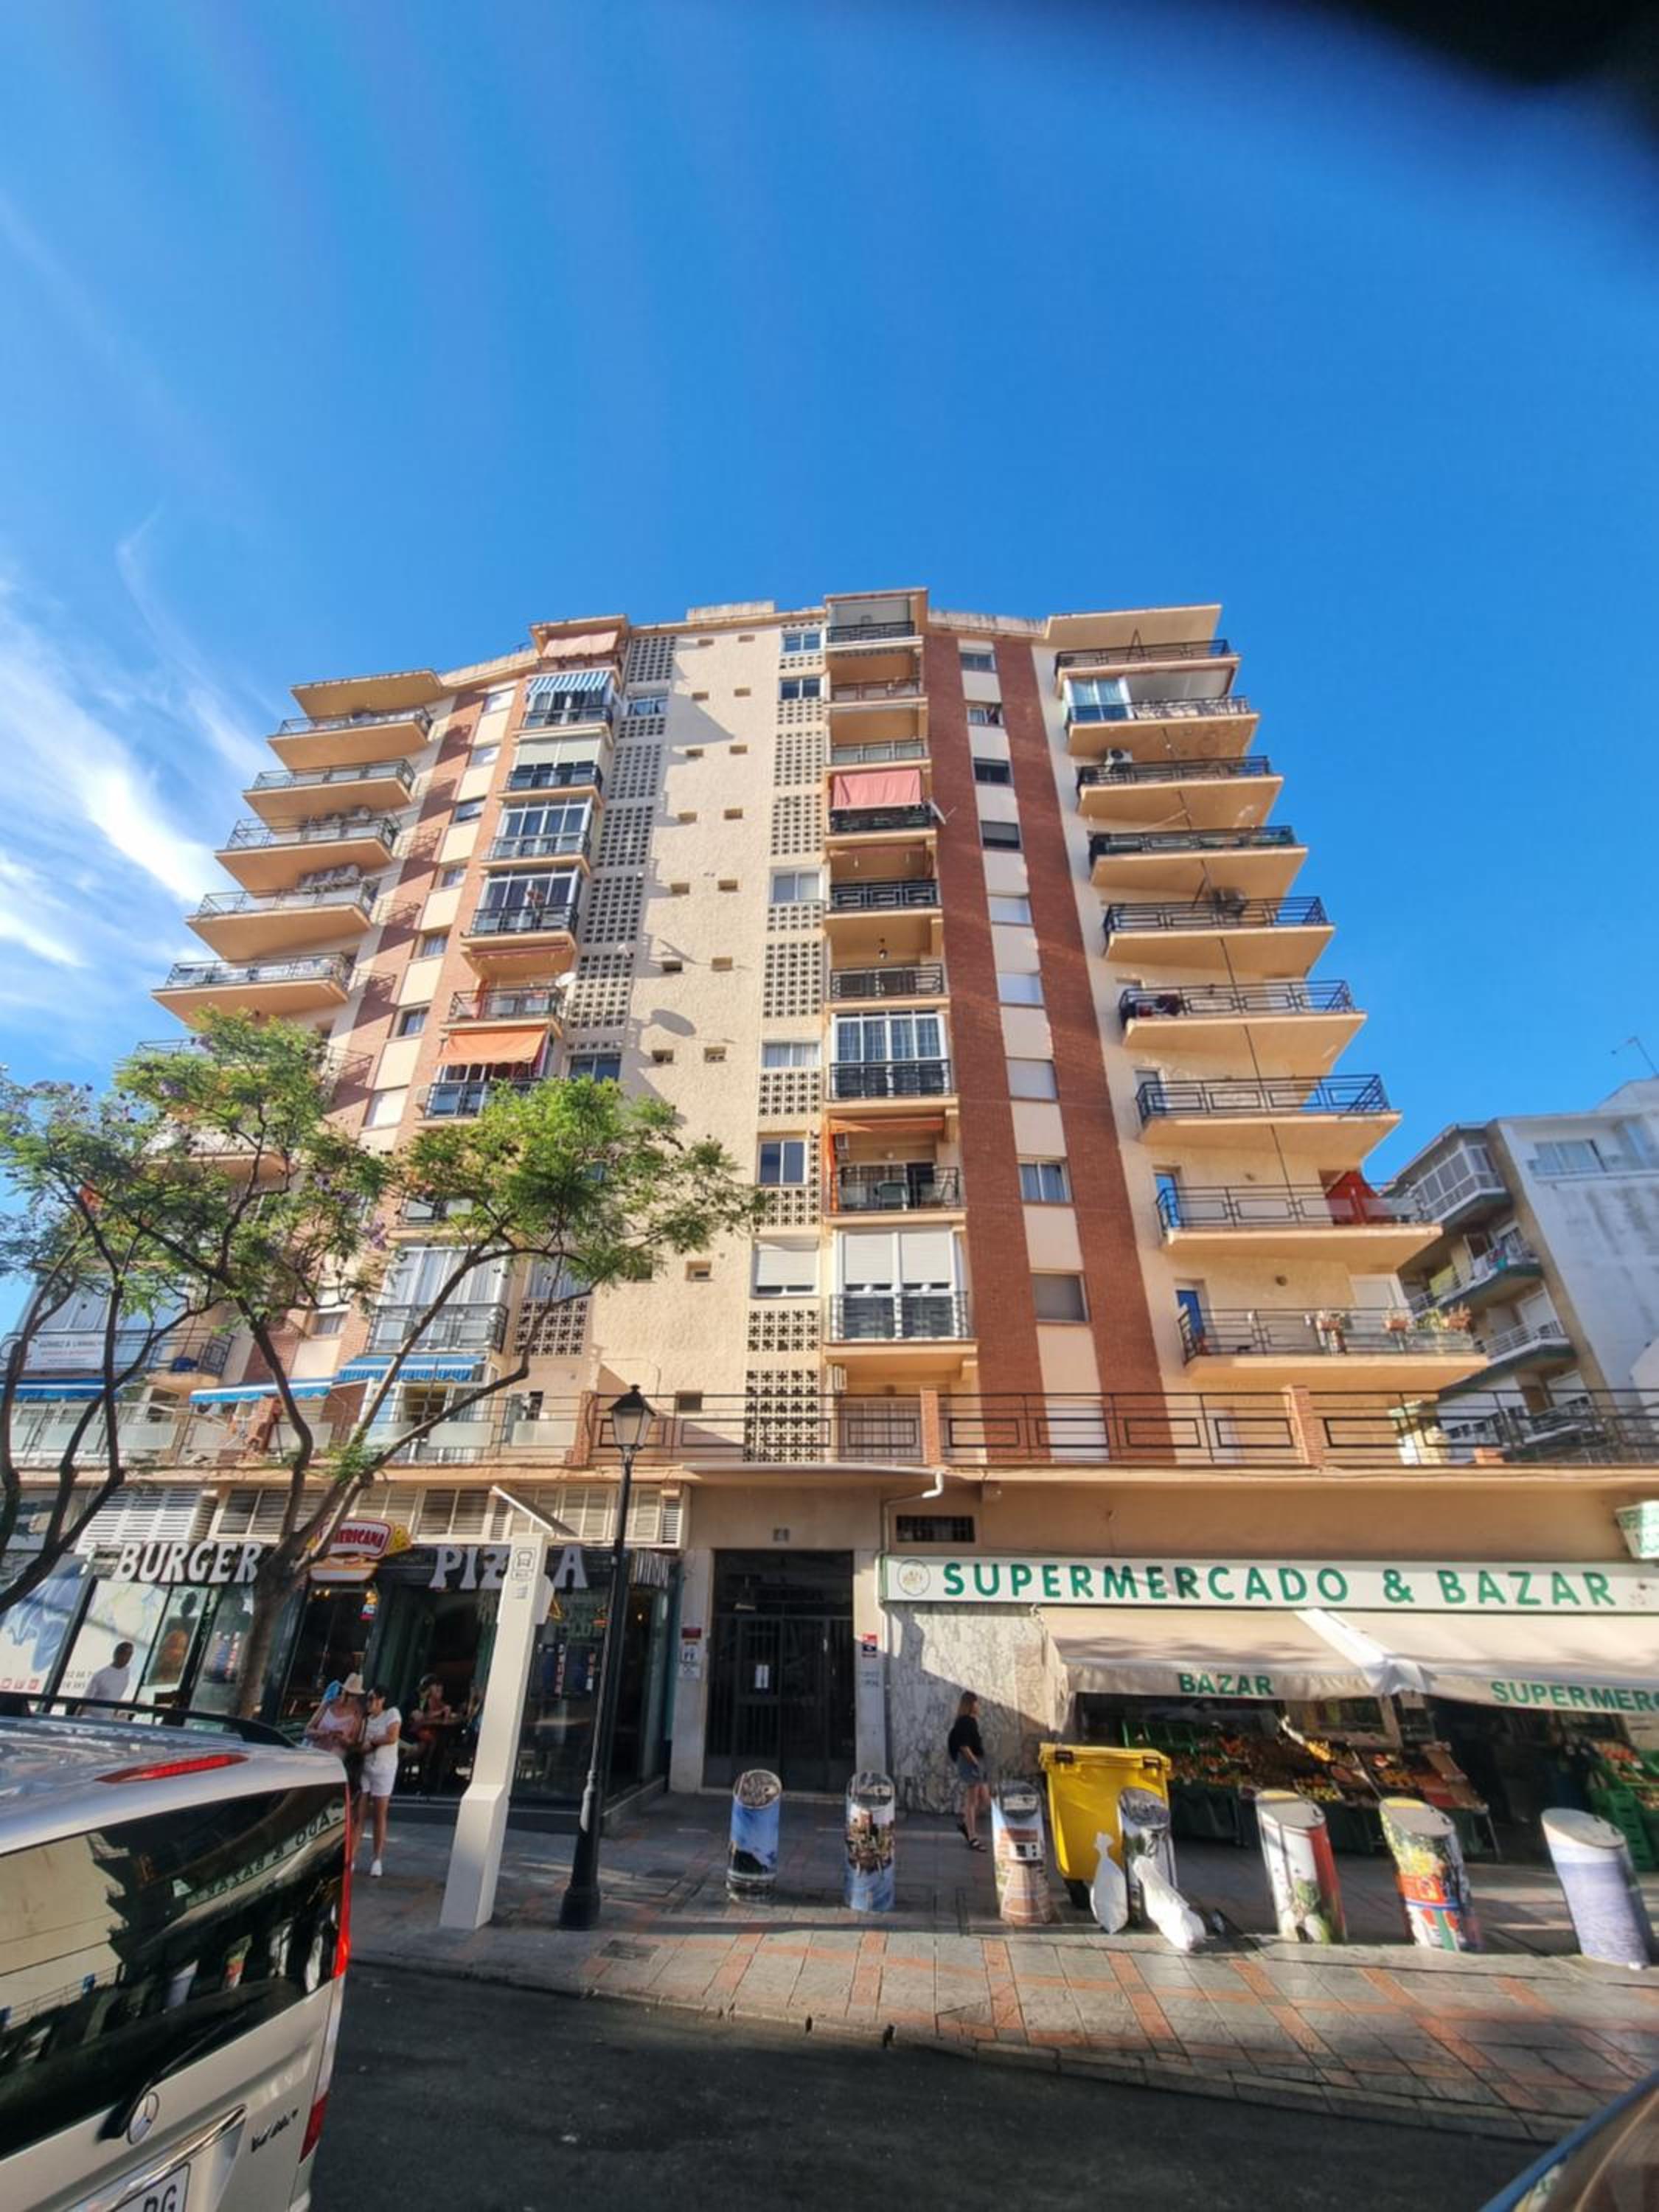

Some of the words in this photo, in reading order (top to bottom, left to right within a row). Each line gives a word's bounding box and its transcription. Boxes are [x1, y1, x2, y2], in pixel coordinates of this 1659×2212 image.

[112, 1540, 262, 1583] BURGER
[428, 1544, 588, 1590] PIZA
[943, 1562, 1349, 1602] SUPERMERCADO
[1383, 1568, 1415, 1603] &
[1437, 1570, 1616, 1605] BAZAR
[1178, 1673, 1275, 1697] BAZAR
